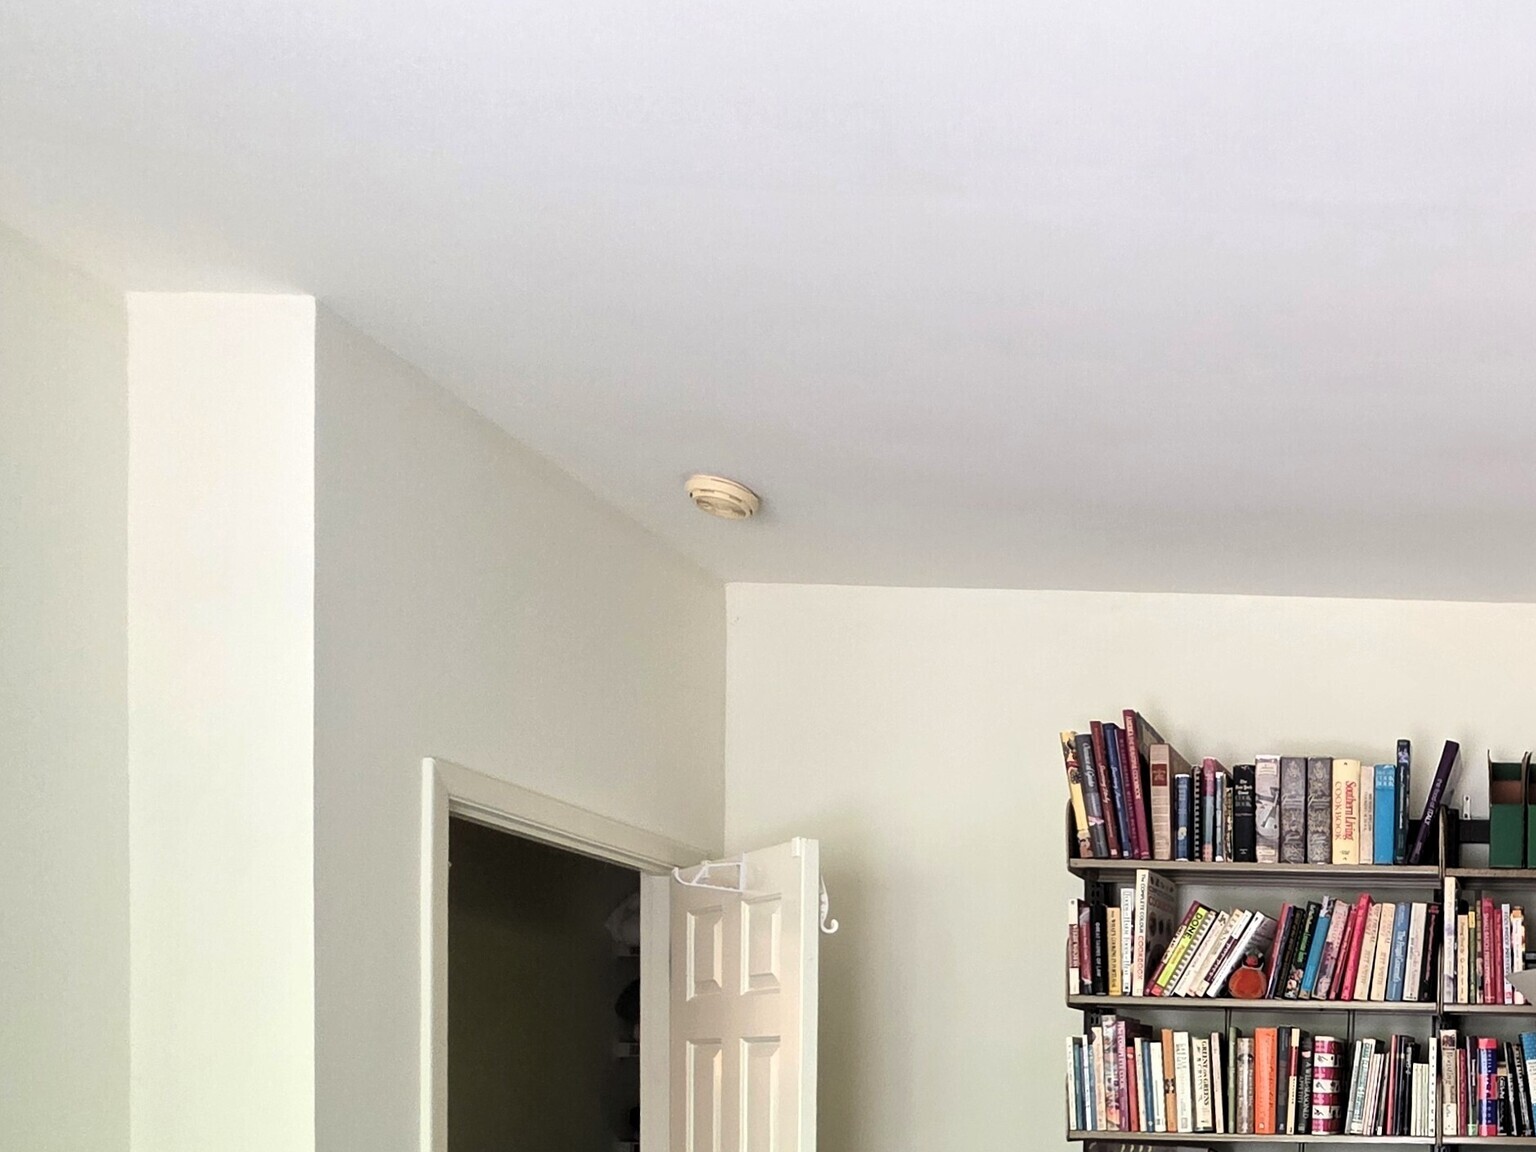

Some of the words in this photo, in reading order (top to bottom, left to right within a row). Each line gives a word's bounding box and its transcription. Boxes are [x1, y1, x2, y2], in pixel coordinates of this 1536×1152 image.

[1132, 769, 1141, 800] COOKBOOK
[1344, 781, 1356, 815] Southern
[1334, 781, 1343, 840] COOKBOOK
[1424, 809, 1434, 825] ITALY
[1343, 817, 1355, 840] Living
[1137, 935, 1145, 980] COOKBOOK
[1302, 1069, 1311, 1119] WELL-SEASONED
